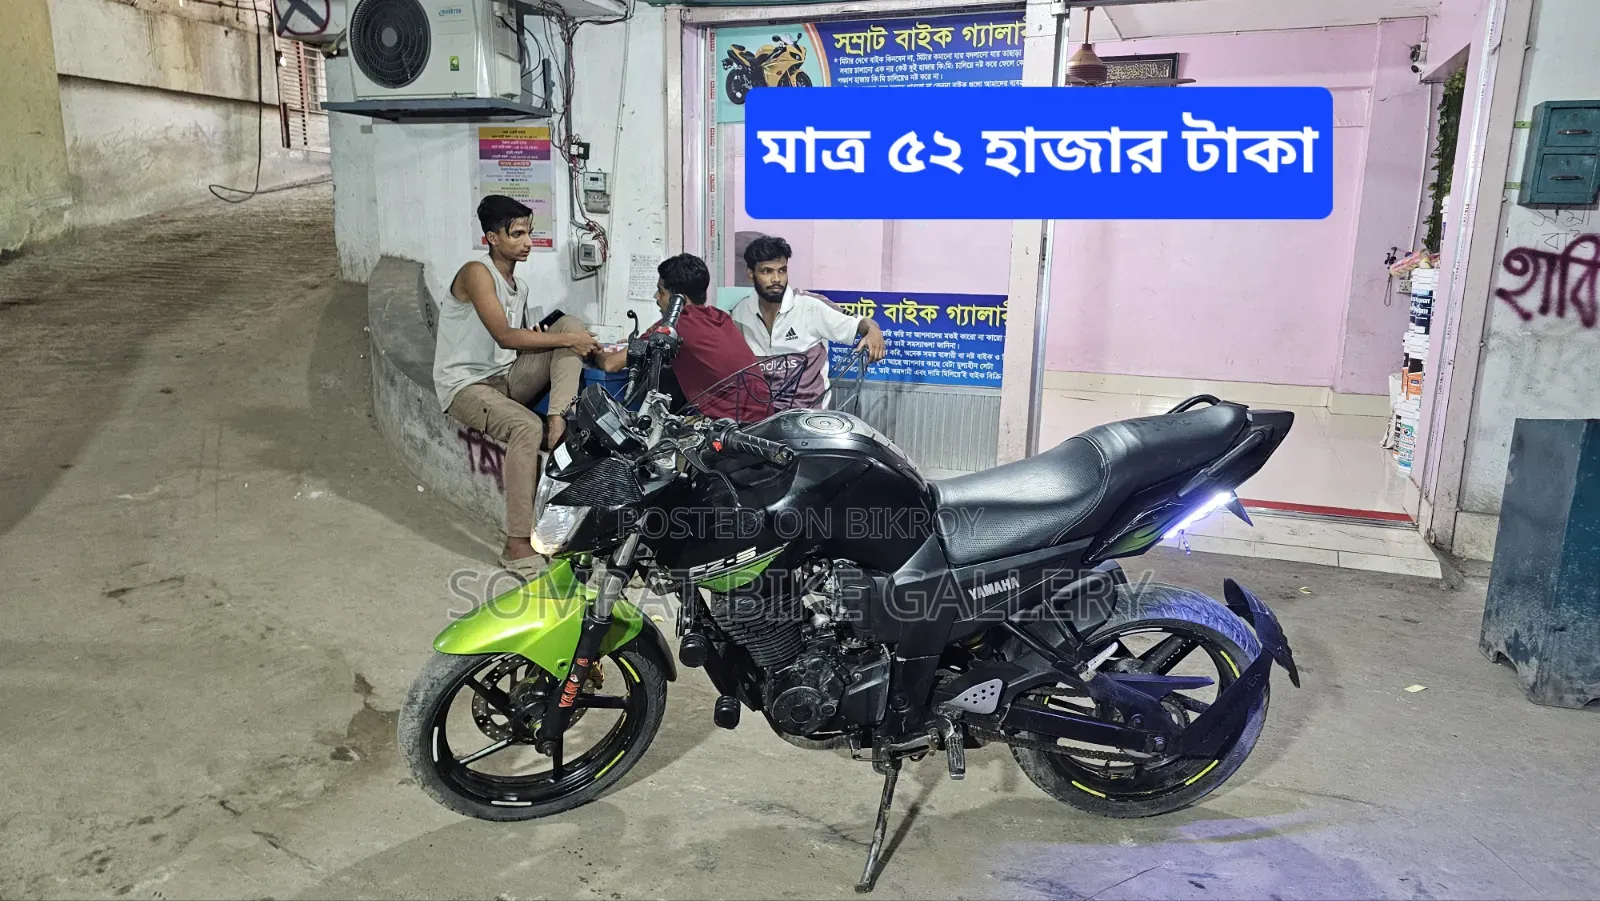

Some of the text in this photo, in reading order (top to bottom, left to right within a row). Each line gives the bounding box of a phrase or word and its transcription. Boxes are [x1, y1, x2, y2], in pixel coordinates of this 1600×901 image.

[833, 24, 888, 56] সম্রাট
[893, 21, 955, 52] বাইক
[882, 297, 940, 326] বাইক
[967, 576, 1020, 600] YAMAHA
[558, 658, 589, 708] YAMA
